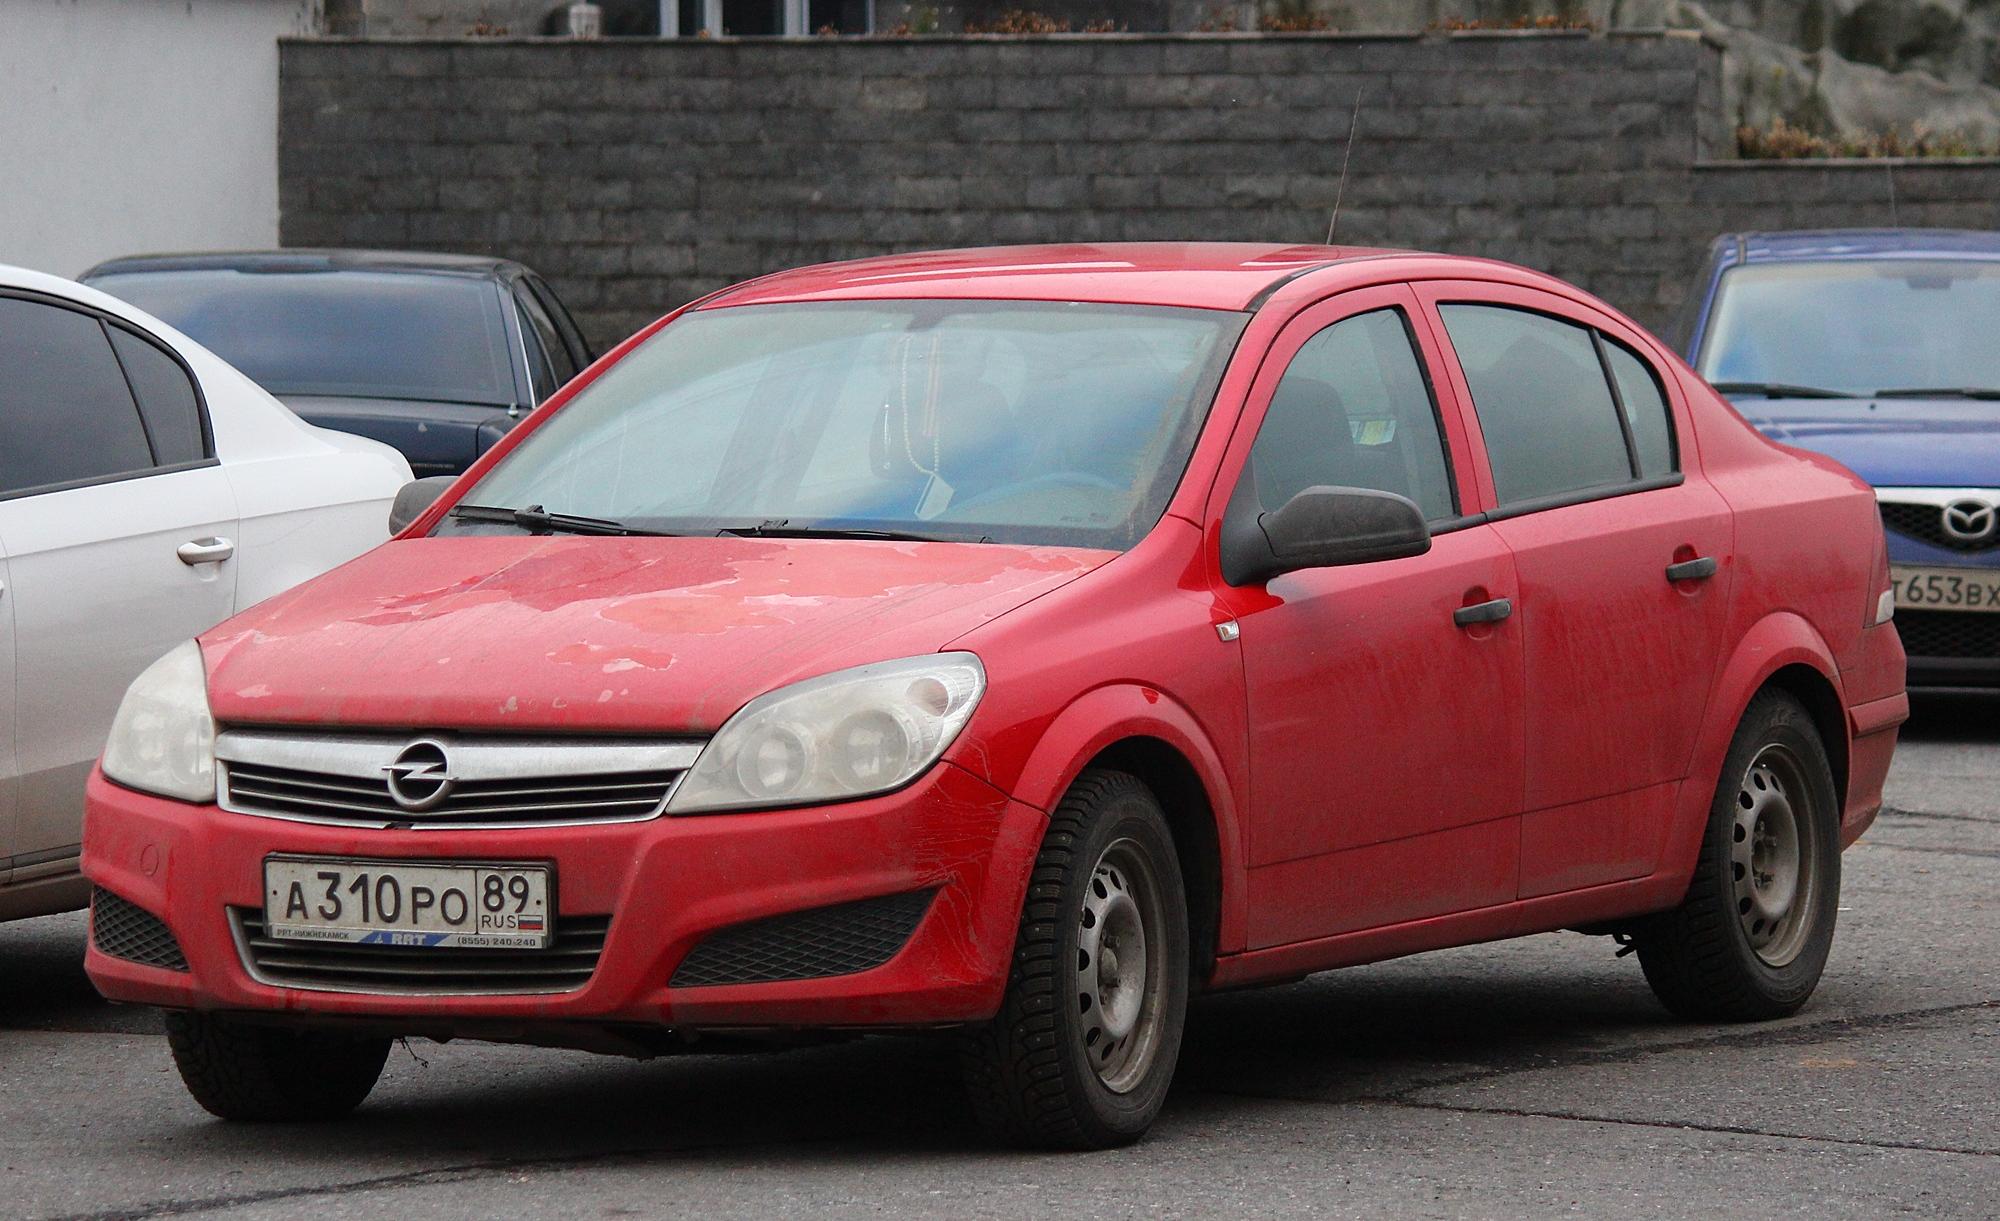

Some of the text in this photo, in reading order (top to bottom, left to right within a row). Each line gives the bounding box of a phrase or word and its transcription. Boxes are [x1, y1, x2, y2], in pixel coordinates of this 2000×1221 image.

[483, 875, 529, 914] 89
[481, 914, 516, 929] RUS
[457, 936, 536, 947] (8555) 240-240
